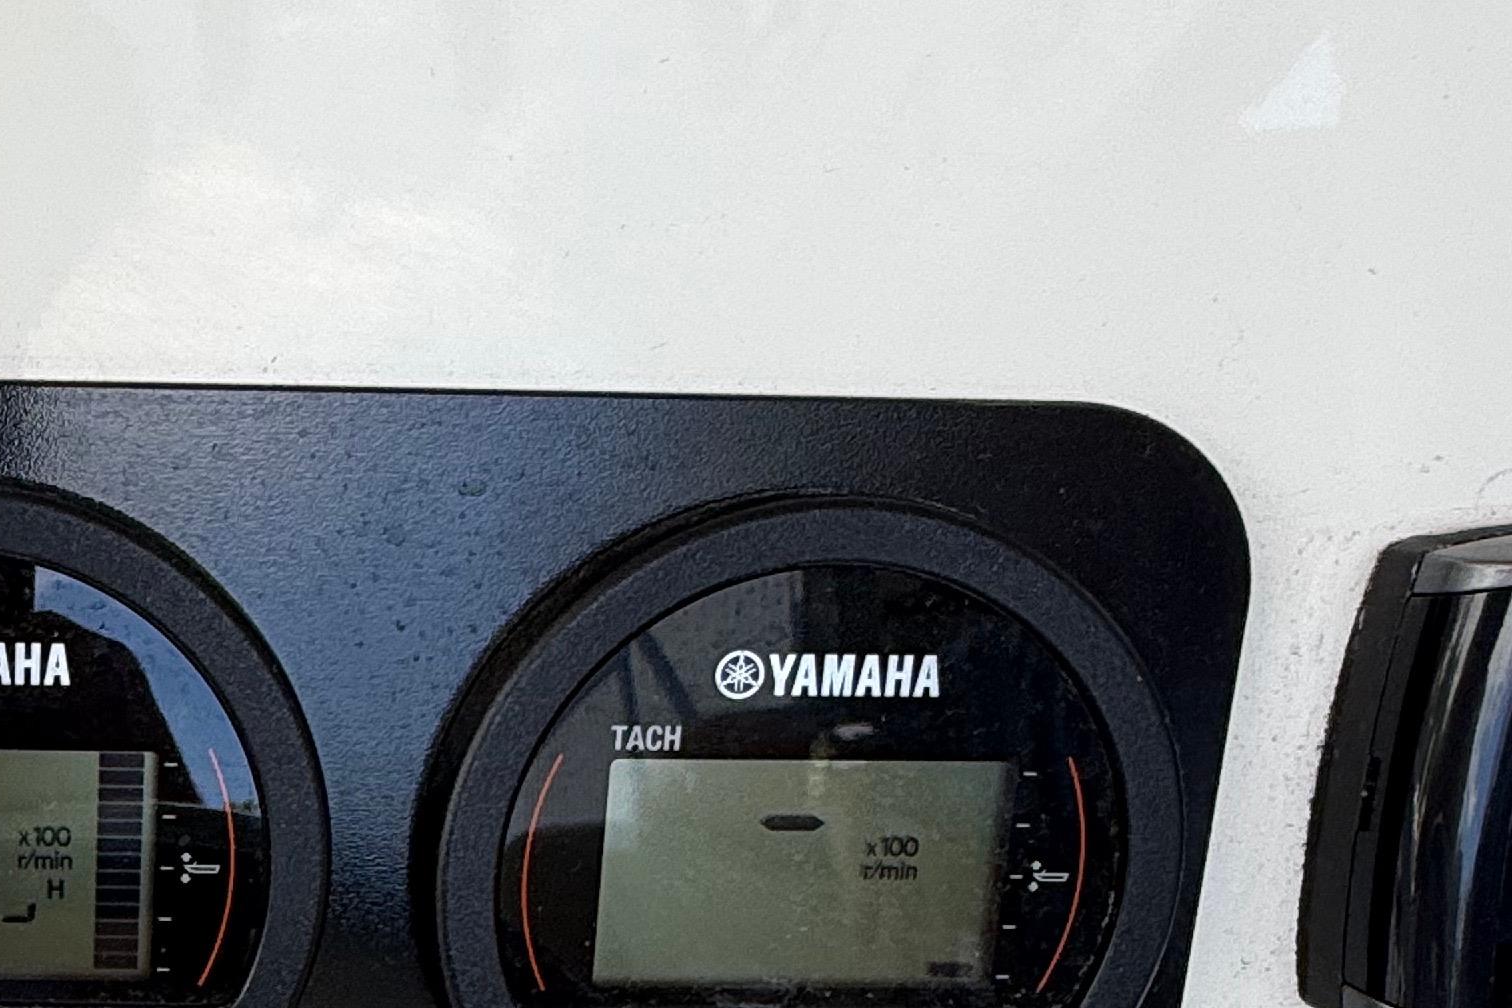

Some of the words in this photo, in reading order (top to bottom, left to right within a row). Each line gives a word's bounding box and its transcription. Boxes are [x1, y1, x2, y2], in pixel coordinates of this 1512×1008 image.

[769, 654, 940, 698] YAMAHA
[611, 725, 683, 752] TACH
[17, 826, 72, 848] x100
[866, 836, 920, 858] x100
[17, 848, 74, 871] r/min
[861, 861, 919, 882] r/min
[47, 879, 66, 900] H
